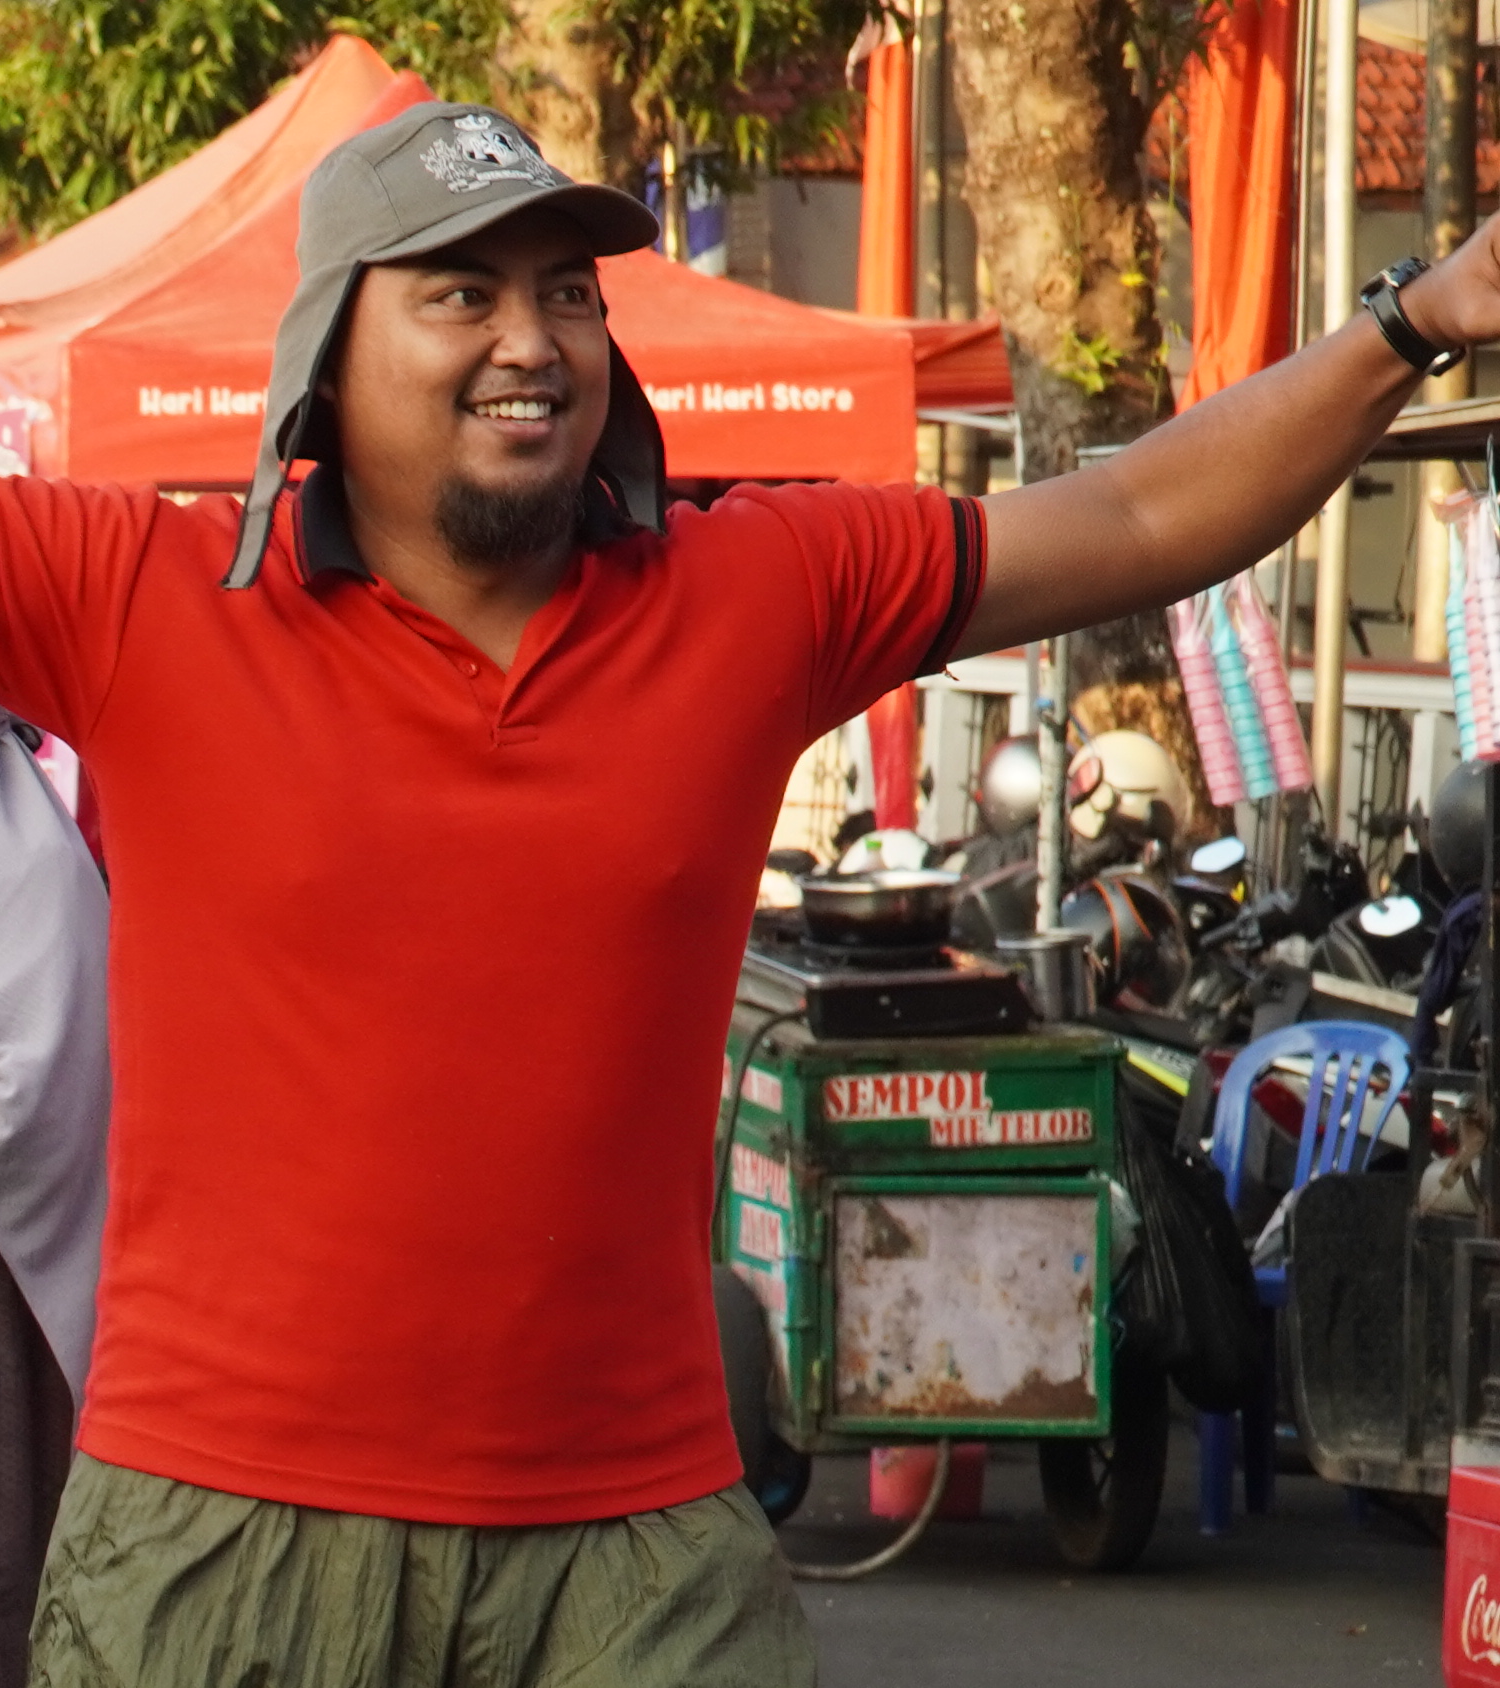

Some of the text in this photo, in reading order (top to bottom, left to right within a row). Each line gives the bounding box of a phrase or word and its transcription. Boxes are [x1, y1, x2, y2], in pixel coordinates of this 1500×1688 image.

[771, 382, 854, 411] Store
[825, 1070, 990, 1117] SEMPOL
[932, 1109, 1092, 1146] MIE TELOR
